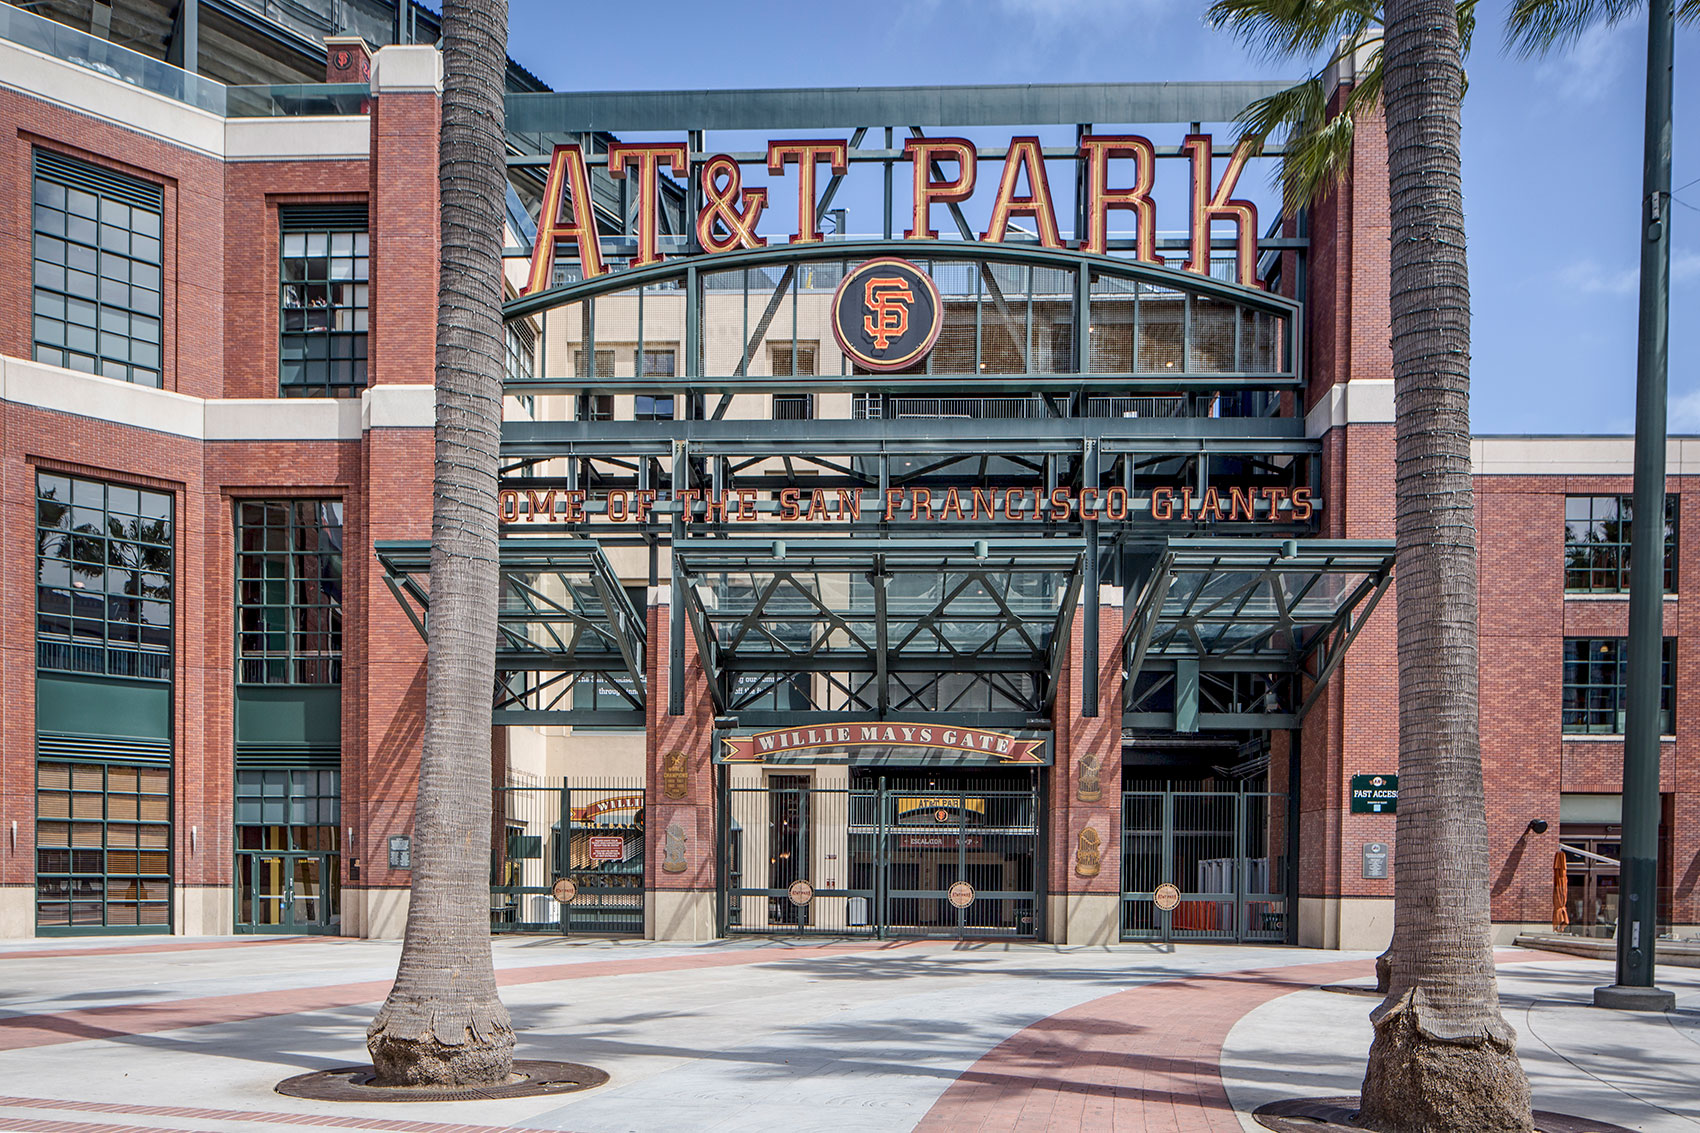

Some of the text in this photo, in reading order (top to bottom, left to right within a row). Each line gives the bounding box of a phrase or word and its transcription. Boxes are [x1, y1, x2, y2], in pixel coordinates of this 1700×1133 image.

[520, 133, 1267, 298] AT&T PARK
[864, 276, 915, 350] SF
[499, 486, 1314, 523] OME OF THE SAN FRANCISCO GIANTS
[598, 687, 621, 696] throug
[758, 726, 1010, 753] WILLIE MAYS GATE
[942, 799, 959, 808] PAR
[1353, 789, 1373, 798] FAST
[597, 798, 643, 812] WILLI
